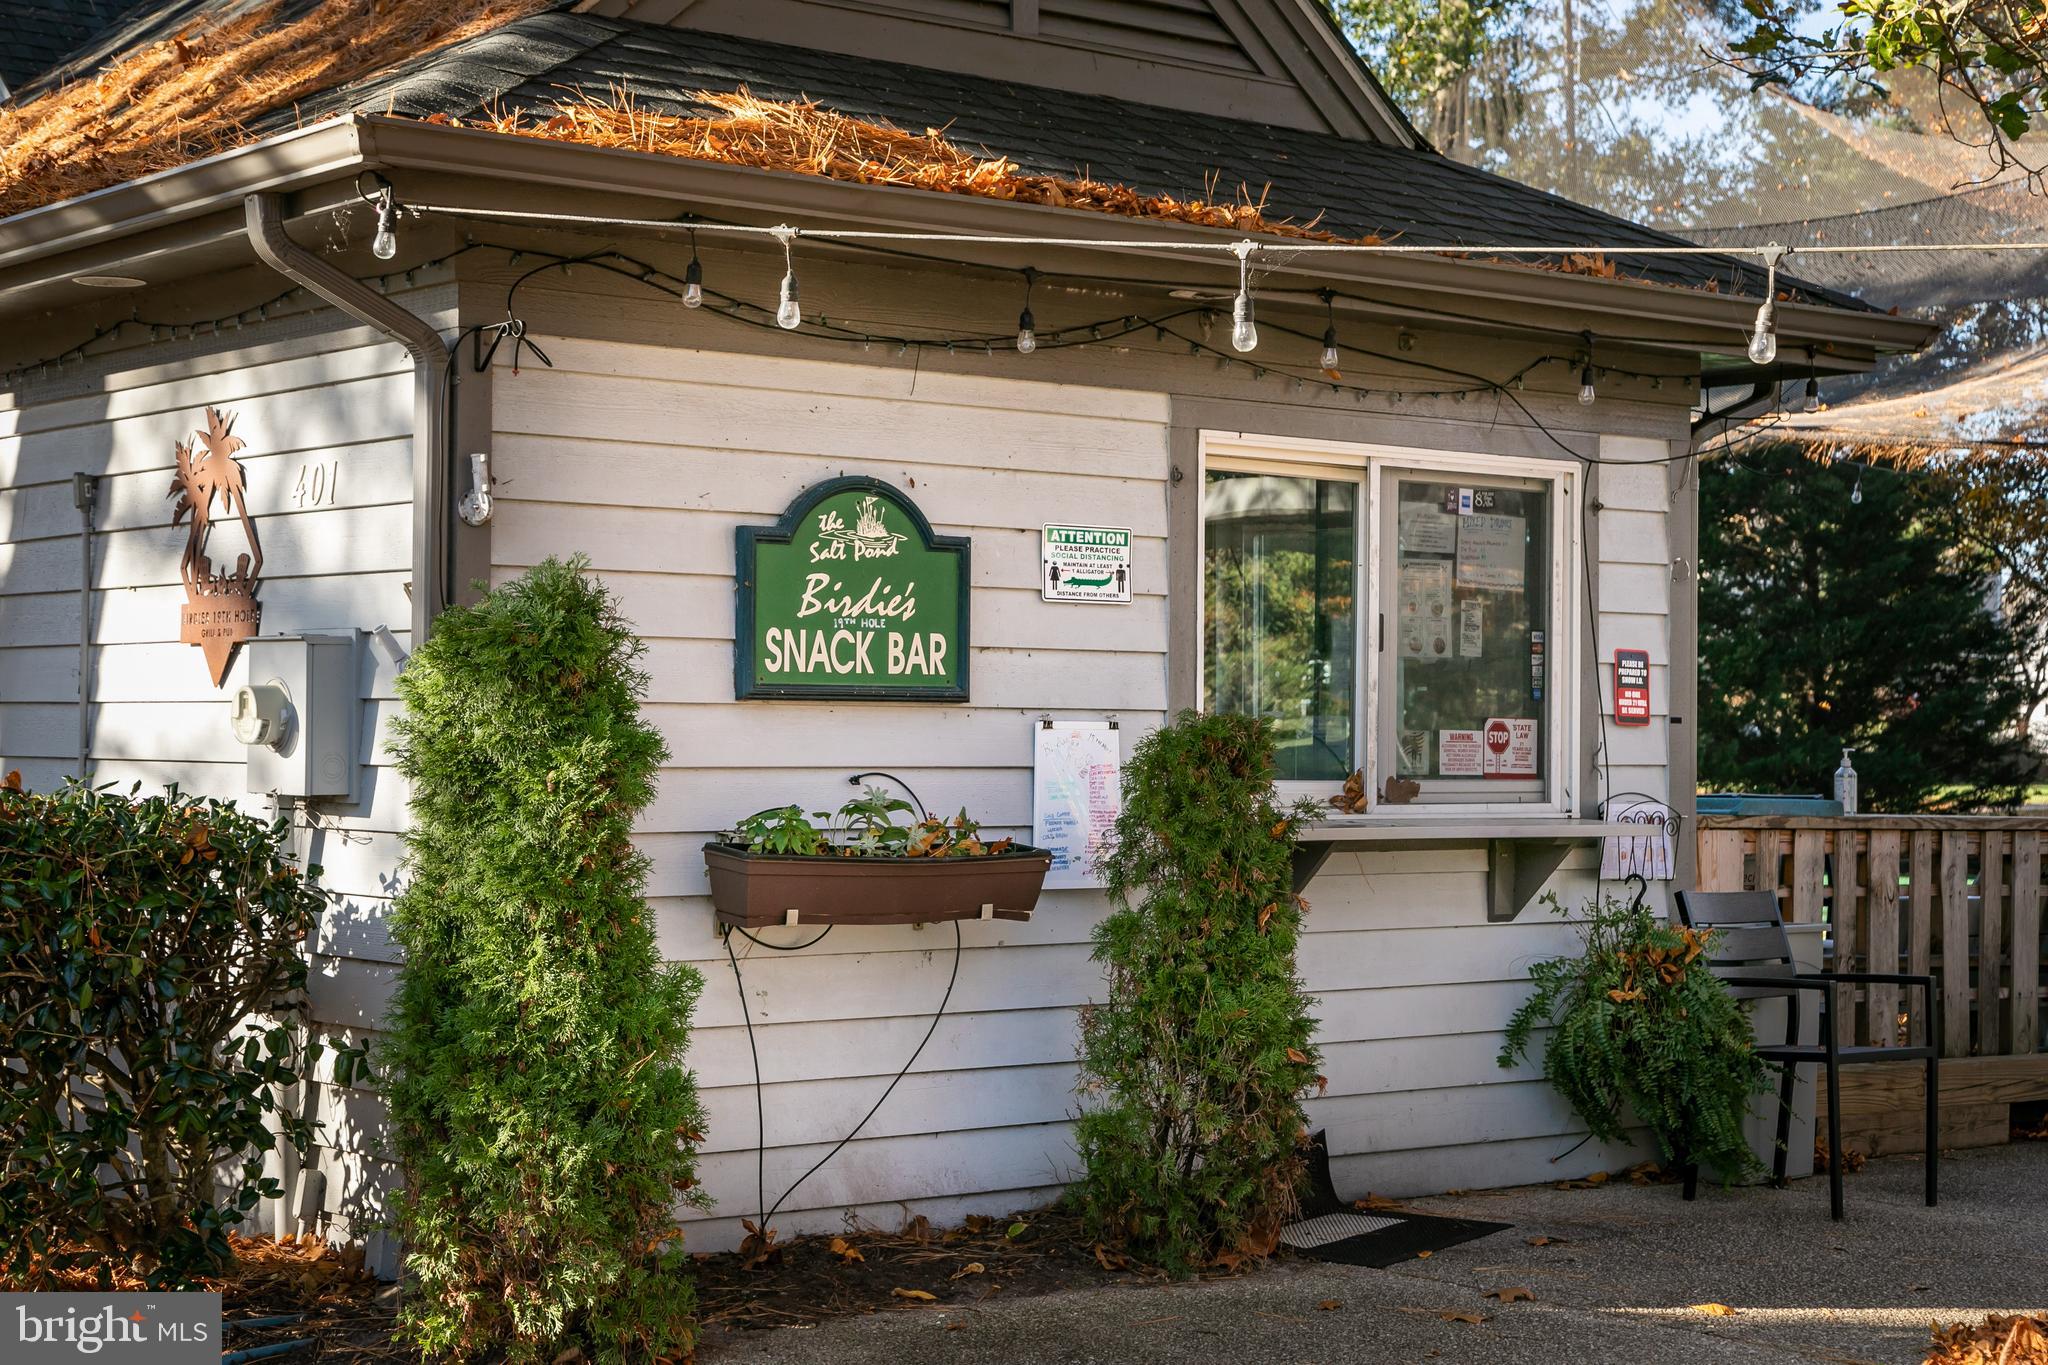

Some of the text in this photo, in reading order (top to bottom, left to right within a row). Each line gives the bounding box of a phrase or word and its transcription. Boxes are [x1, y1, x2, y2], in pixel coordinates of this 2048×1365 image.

[291, 460, 338, 508] 401
[1050, 530, 1124, 544] ATTENTION
[809, 537, 899, 564] Salt Pond
[1055, 545, 1083, 553] PLEASE
[1080, 553, 1124, 562] DISTANCING
[796, 572, 917, 622] Birdie's
[833, 618, 886, 629] 19TH HOLE
[764, 627, 948, 676] SNACK BAR
[1641, 669, 1647, 677] TO
[1512, 724, 1532, 732] STATE
[1449, 732, 1473, 741] WARNING
[1488, 731, 1509, 744] STOP
